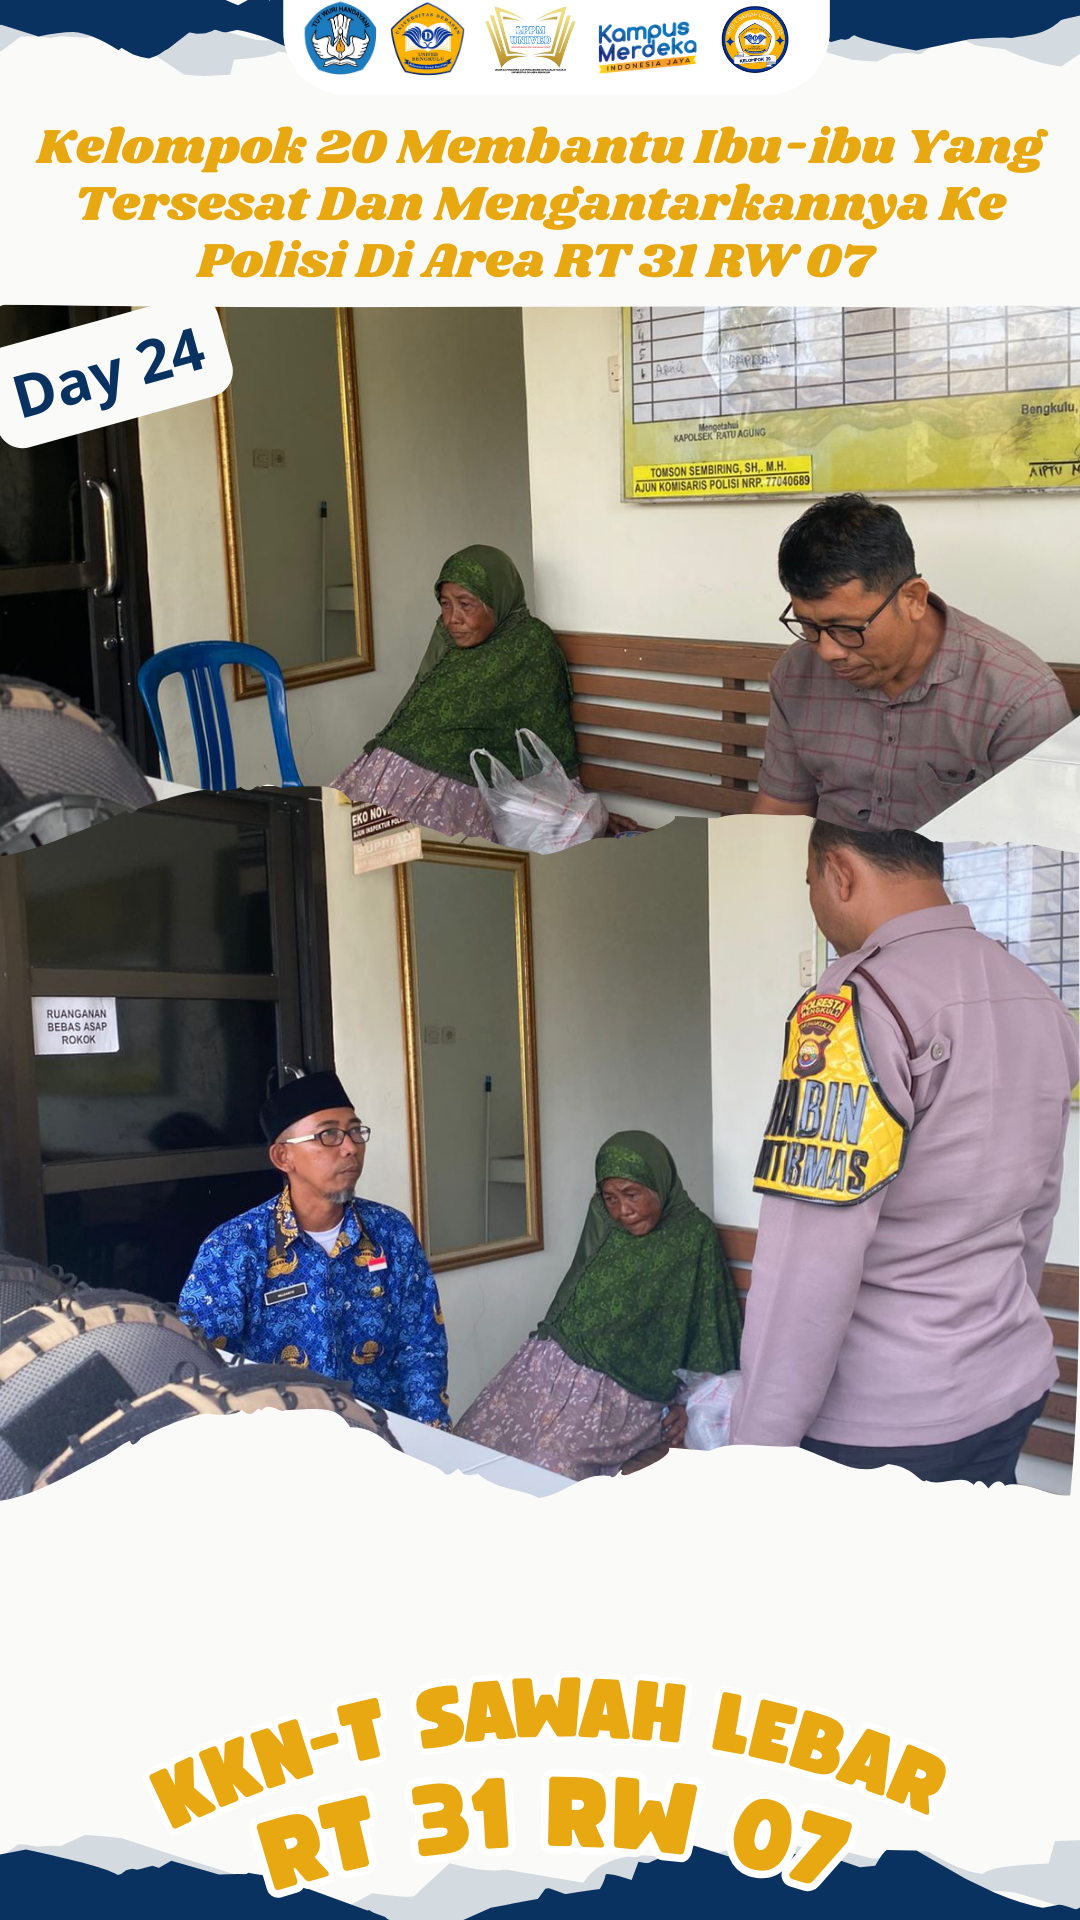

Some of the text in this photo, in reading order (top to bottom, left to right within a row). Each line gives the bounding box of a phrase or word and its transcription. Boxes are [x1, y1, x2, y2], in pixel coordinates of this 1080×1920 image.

[1021, 401, 1078, 416] Bengkulu,
[698, 421, 739, 433] Mengetahui
[674, 427, 766, 443] KAPOLSEK RATU AGUNG
[651, 466, 687, 478] TOMSON
[689, 463, 742, 476] SEMBIRING,
[766, 461, 787, 472] M.H.
[1029, 465, 1062, 478] AIPTU
[635, 475, 810, 493] AJUN KOMISARIS POLISI NRP. 77040689
[352, 806, 390, 826] EKO NOV
[357, 832, 415, 855] SUPRIADI
[801, 998, 846, 1013] POLRESTA
[801, 1007, 841, 1019] BENGKULU
[47, 1009, 106, 1019] RUANGANAN
[48, 1022, 107, 1032] BEBAS ASAP
[62, 1035, 96, 1045] ROKOK
